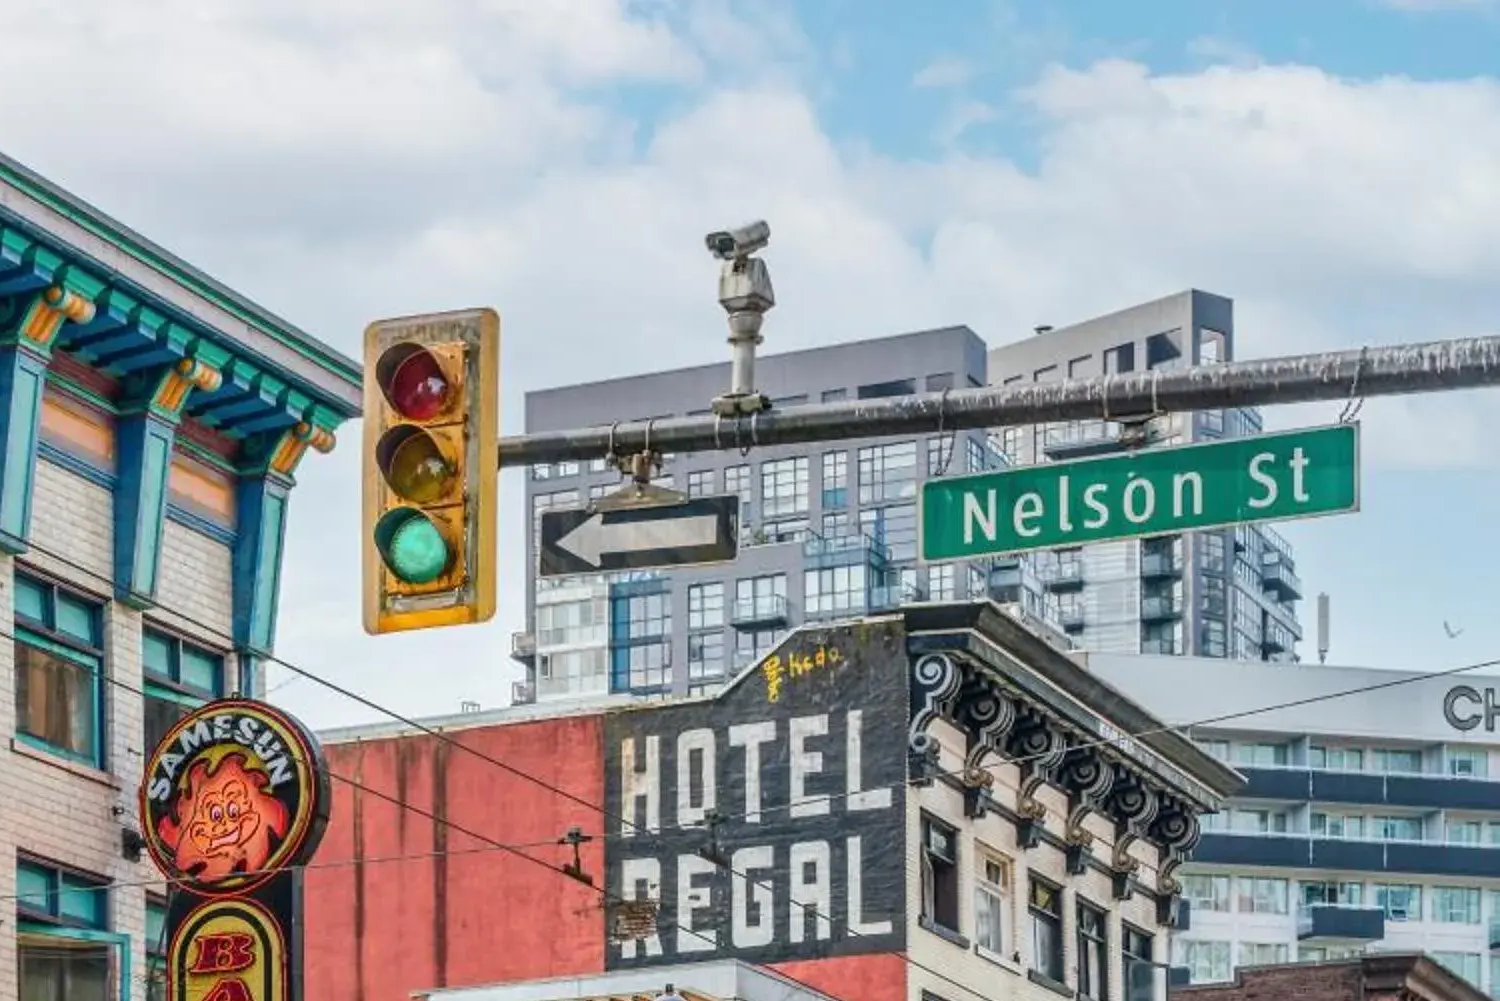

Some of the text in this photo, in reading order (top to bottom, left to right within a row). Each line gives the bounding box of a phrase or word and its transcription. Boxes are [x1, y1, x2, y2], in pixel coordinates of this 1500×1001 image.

[962, 446, 1310, 545] Nelson St
[147, 714, 293, 801] SAMESUN
[620, 709, 893, 838] HOTEL
[620, 835, 893, 960] REGAL
